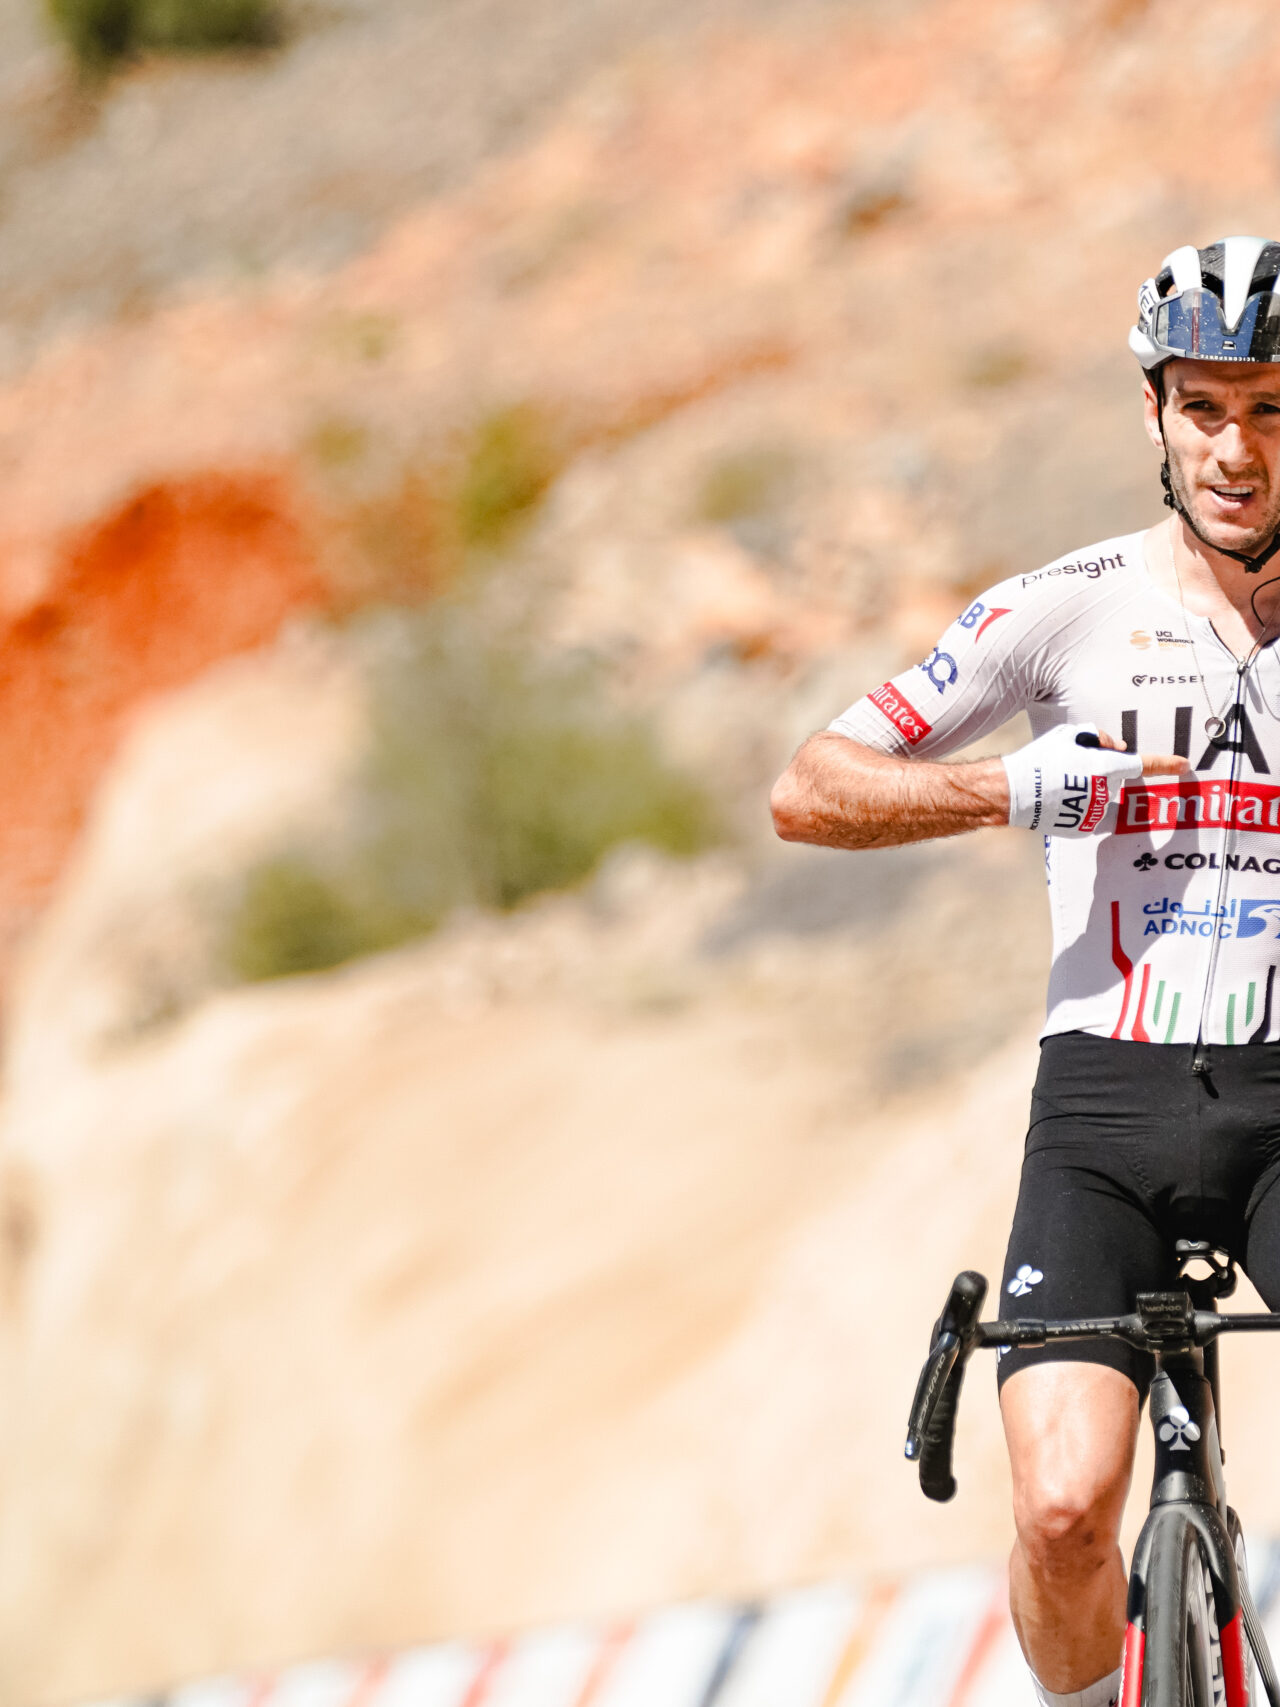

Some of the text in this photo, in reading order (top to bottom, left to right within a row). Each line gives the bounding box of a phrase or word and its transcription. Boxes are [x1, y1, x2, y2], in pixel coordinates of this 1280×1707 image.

[1022, 553, 1126, 588] presight
[1053, 772, 1088, 829] UAE
[1081, 777, 1107, 831] Emirates
[1143, 918, 1233, 939] ADNOC
